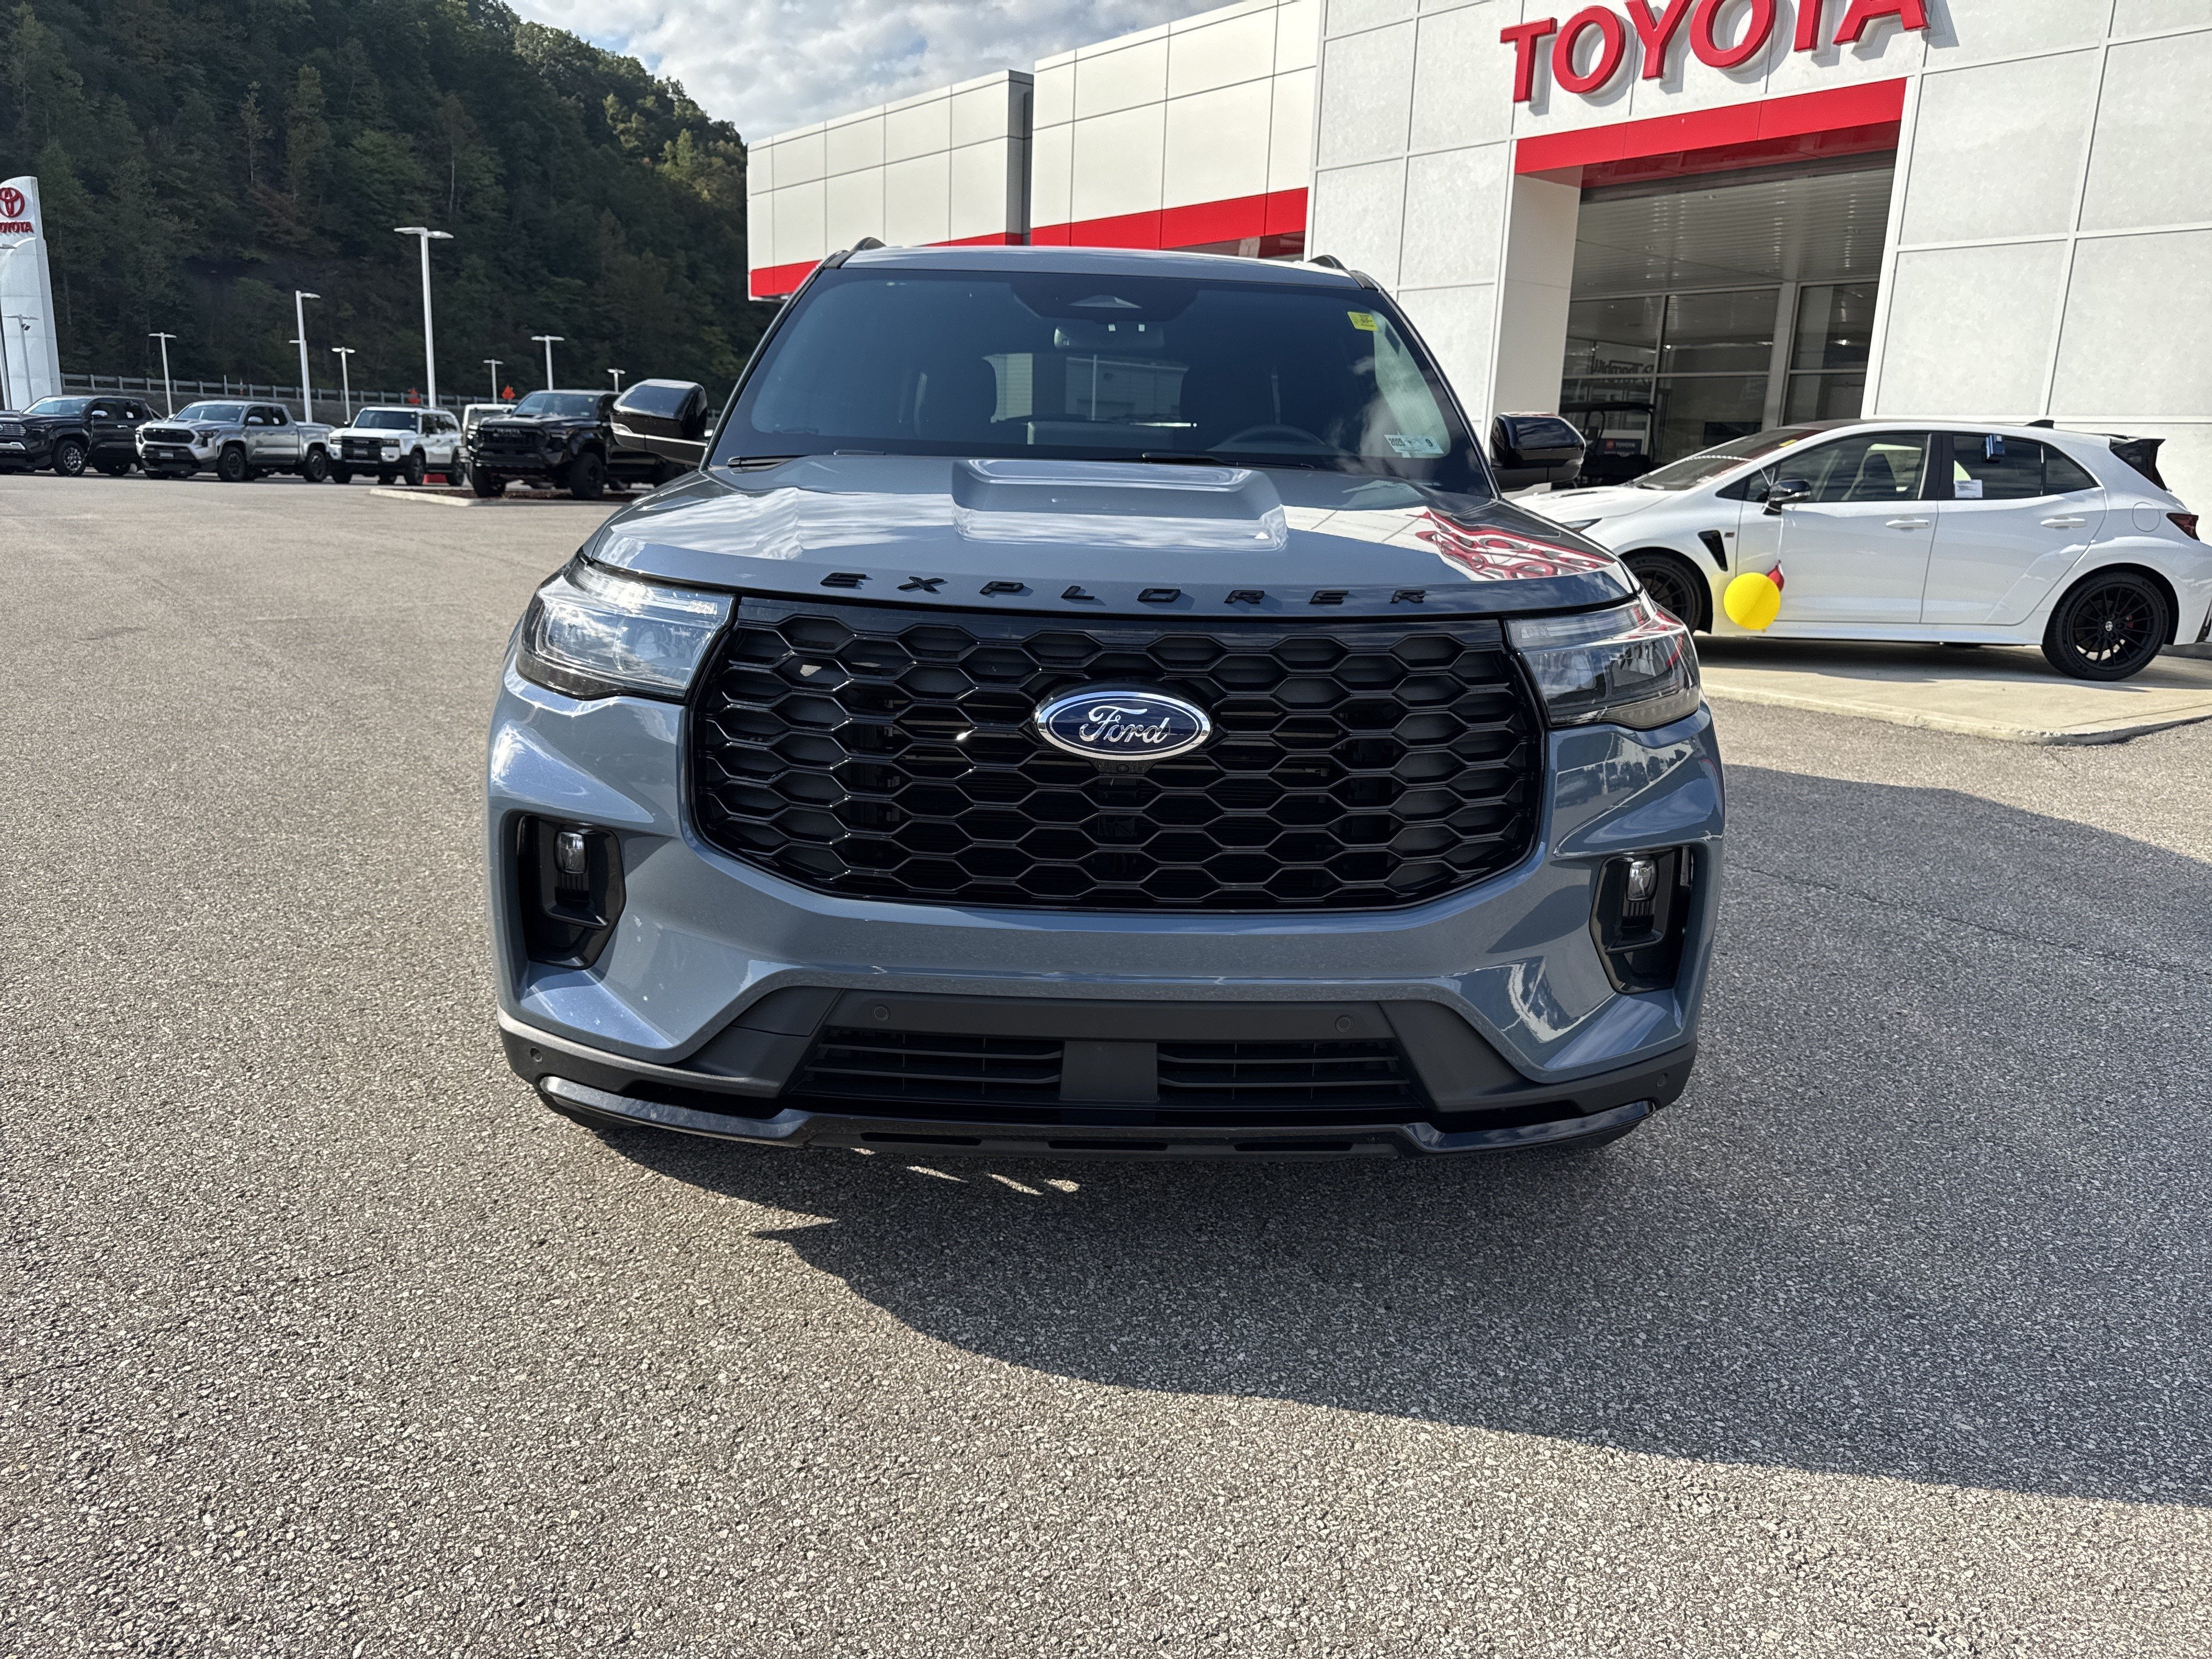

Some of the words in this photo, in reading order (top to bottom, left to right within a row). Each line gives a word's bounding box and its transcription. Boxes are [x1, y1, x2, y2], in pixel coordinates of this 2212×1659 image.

[0, 222, 34, 233] OYOTA
[1425, 438, 1434, 447] 9
[820, 572, 1426, 605] EXPLORER
[1079, 706, 1170, 743] Ford
